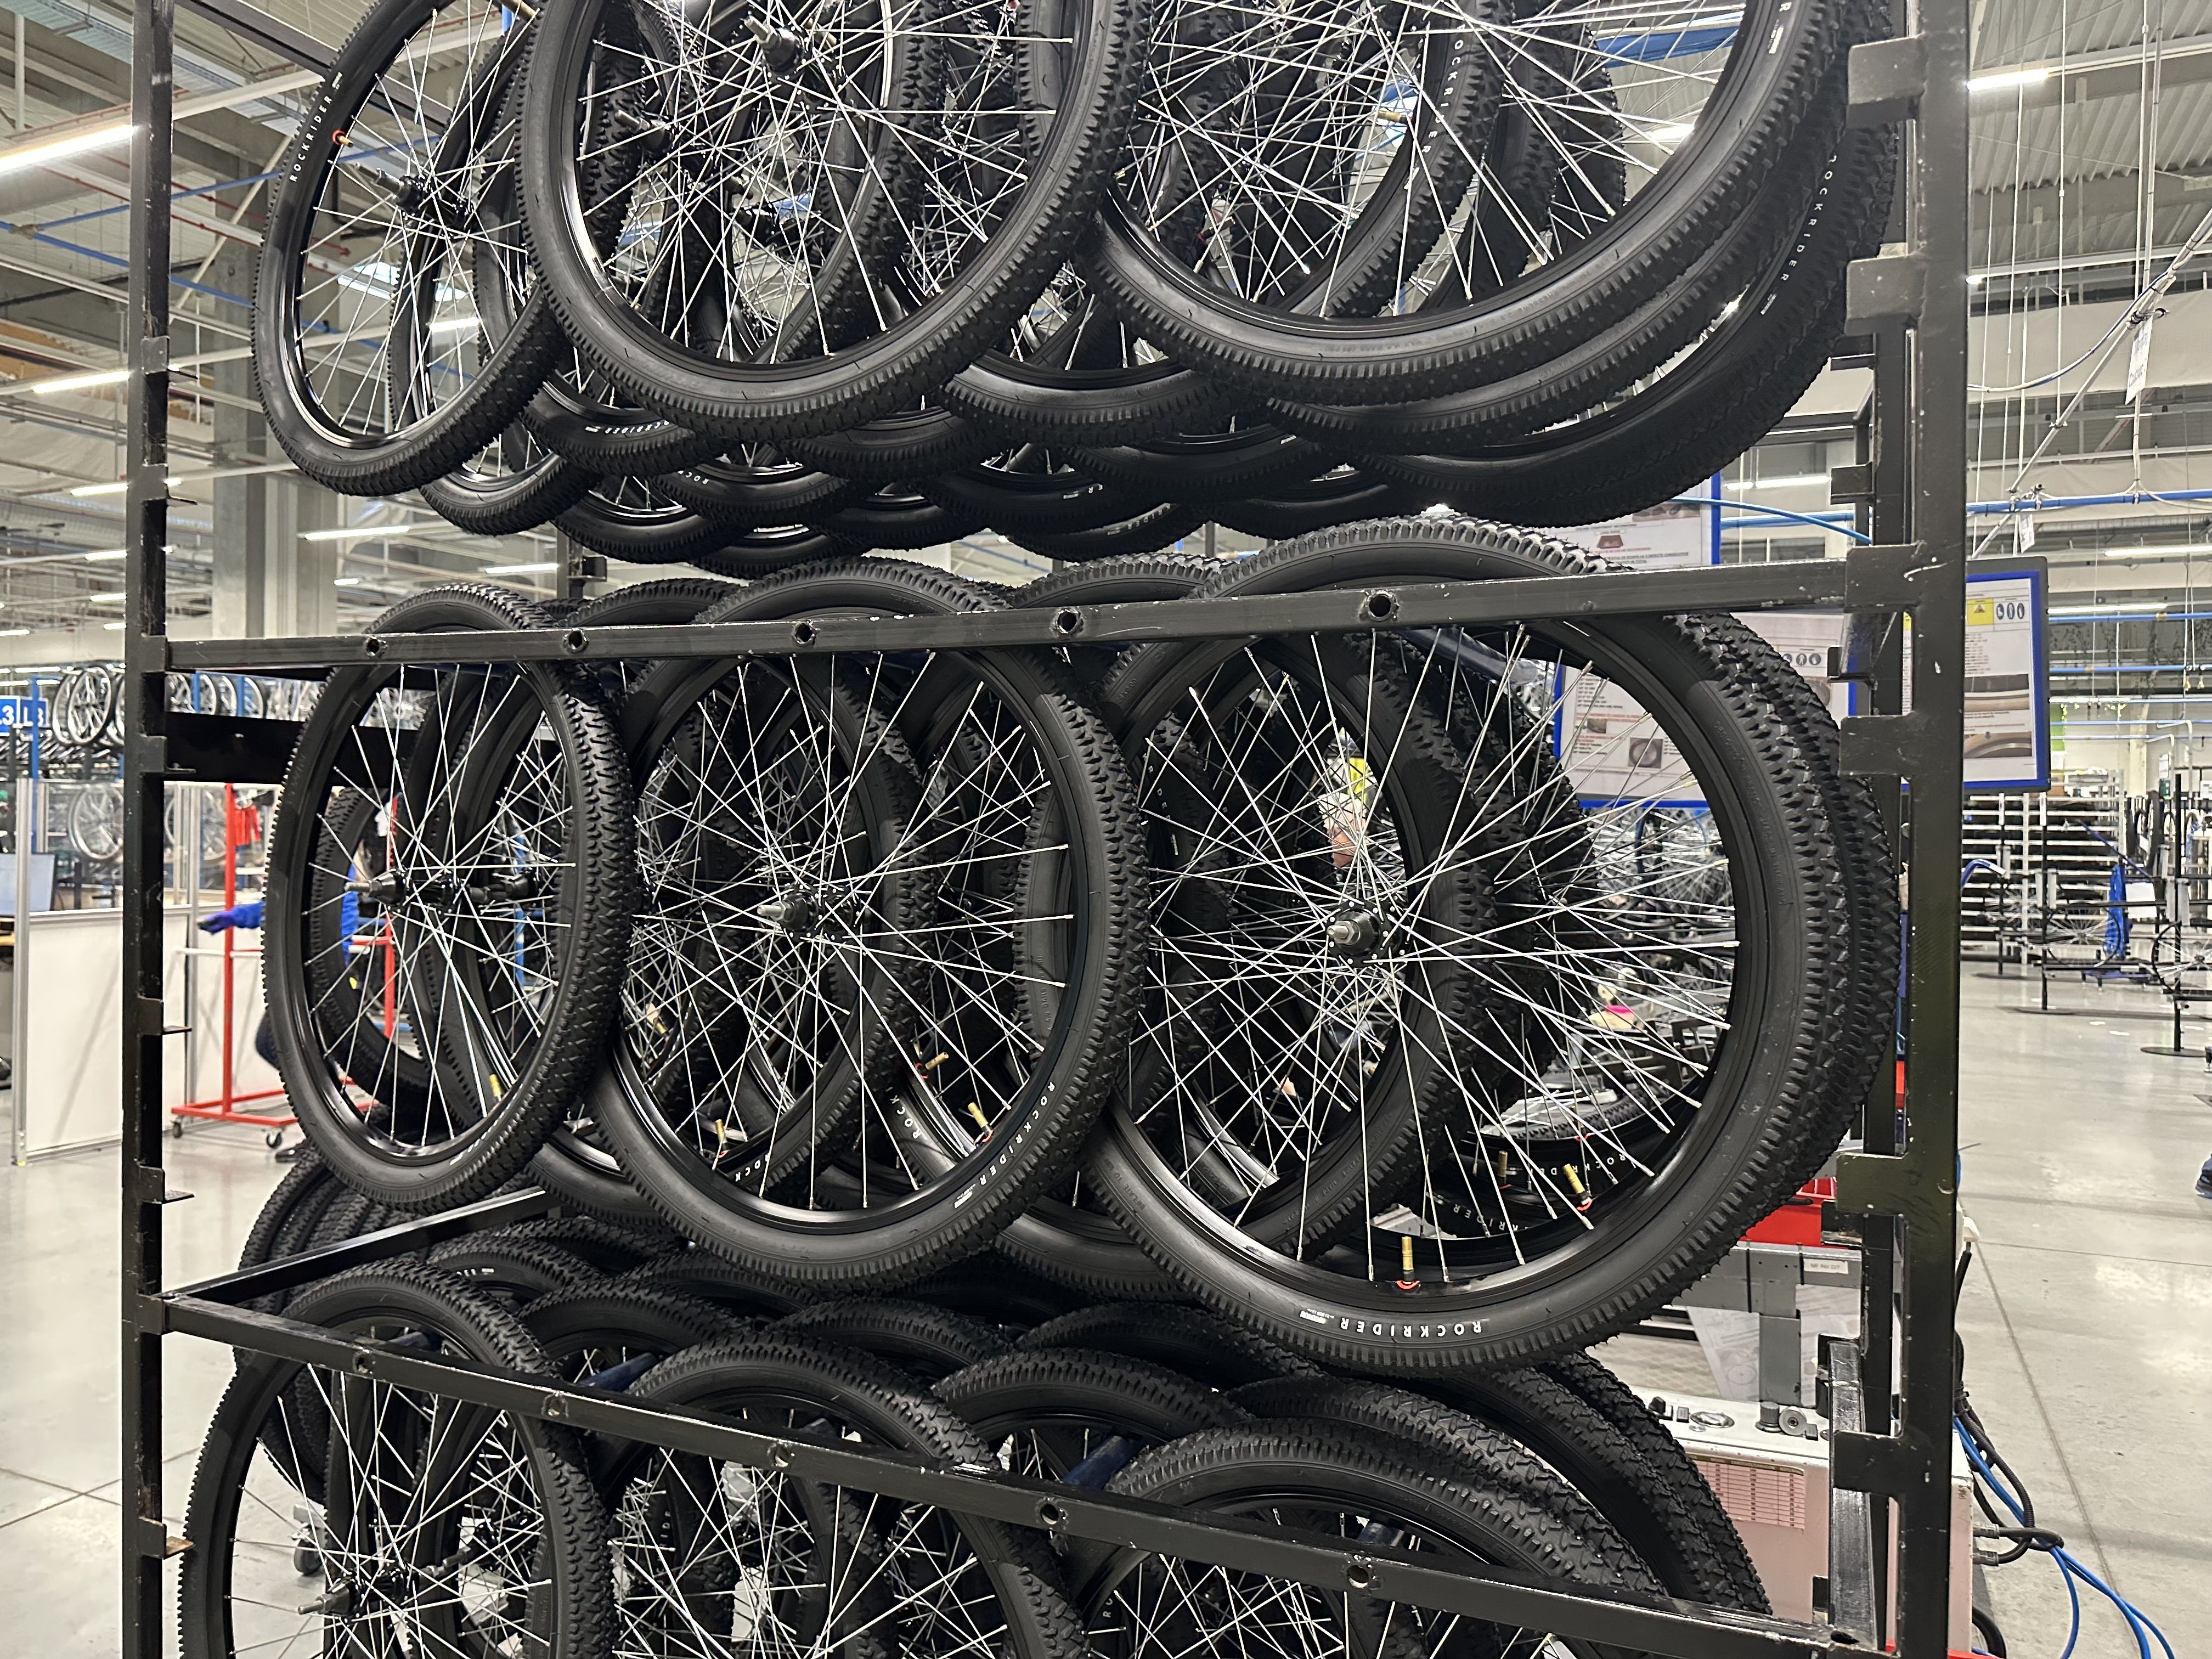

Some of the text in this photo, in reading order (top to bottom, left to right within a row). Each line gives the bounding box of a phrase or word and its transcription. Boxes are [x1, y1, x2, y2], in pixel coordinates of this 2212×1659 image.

[289, 95, 332, 182] ROCKRIDER
[0, 705, 15, 725] 3
[886, 1088, 922, 1140] ROCK
[979, 1082, 1056, 1186] ROCKRIDER
[1340, 1317, 1482, 1338] ROCKRIDER
